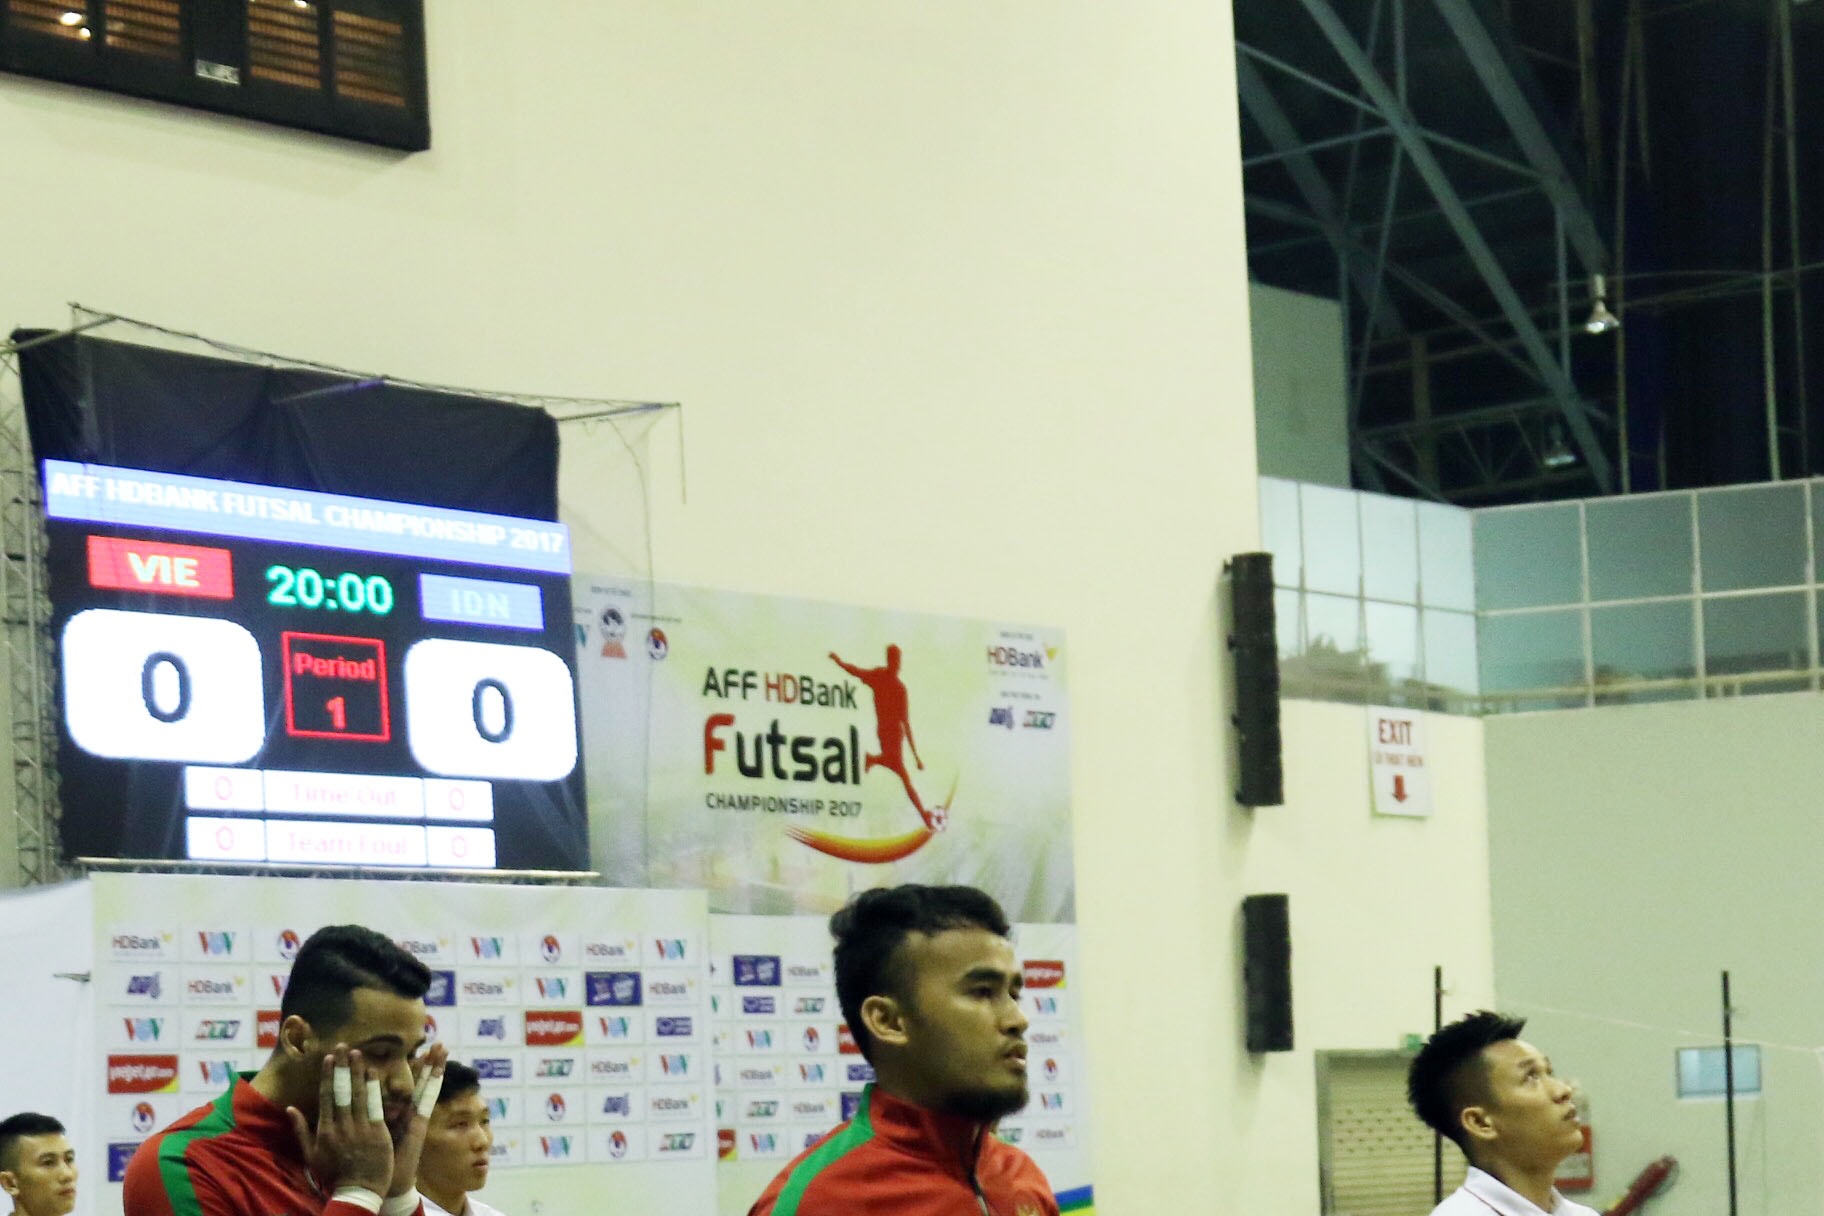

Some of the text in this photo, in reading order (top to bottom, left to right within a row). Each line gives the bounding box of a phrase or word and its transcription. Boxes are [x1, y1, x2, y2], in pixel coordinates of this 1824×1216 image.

[52, 472, 564, 553] AFF HDBANK FUTSAL CHAMPIONSHIP 2017
[127, 551, 199, 587] VIE
[264, 563, 394, 616] 20:00
[450, 588, 511, 619] IDN
[293, 651, 377, 681] Period
[987, 645, 1044, 669] HDBank
[140, 650, 193, 724] 0
[702, 665, 859, 710] AFF HDBank
[326, 696, 347, 729] 1
[471, 677, 514, 744] 0
[703, 712, 861, 786] Futsal
[1378, 718, 1412, 746] EXIT
[705, 791, 863, 818] CHAMPIONSHIP 2017
[112, 935, 161, 950] HDBank
